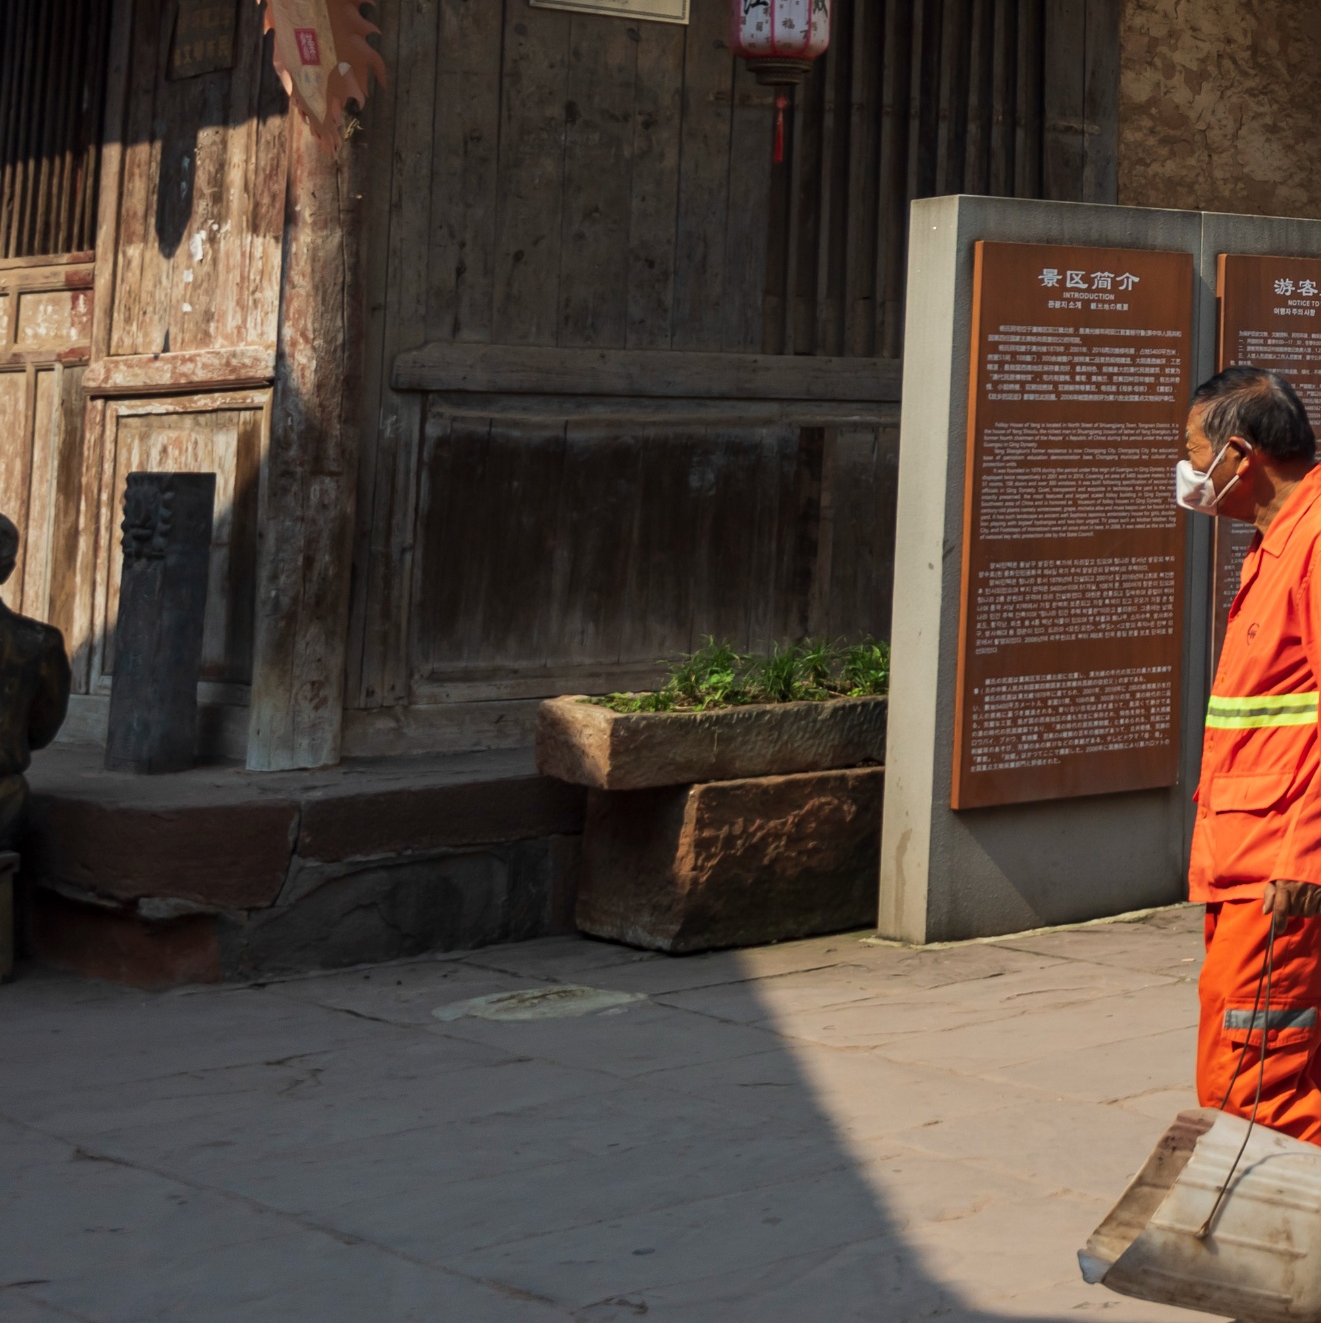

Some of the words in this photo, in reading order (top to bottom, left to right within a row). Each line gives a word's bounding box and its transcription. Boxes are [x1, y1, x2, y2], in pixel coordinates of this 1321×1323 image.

[1038, 268, 1140, 291] 景区简介
[1063, 291, 1115, 300] INTRODUCTION
[1287, 299, 1310, 307] NOTICE
